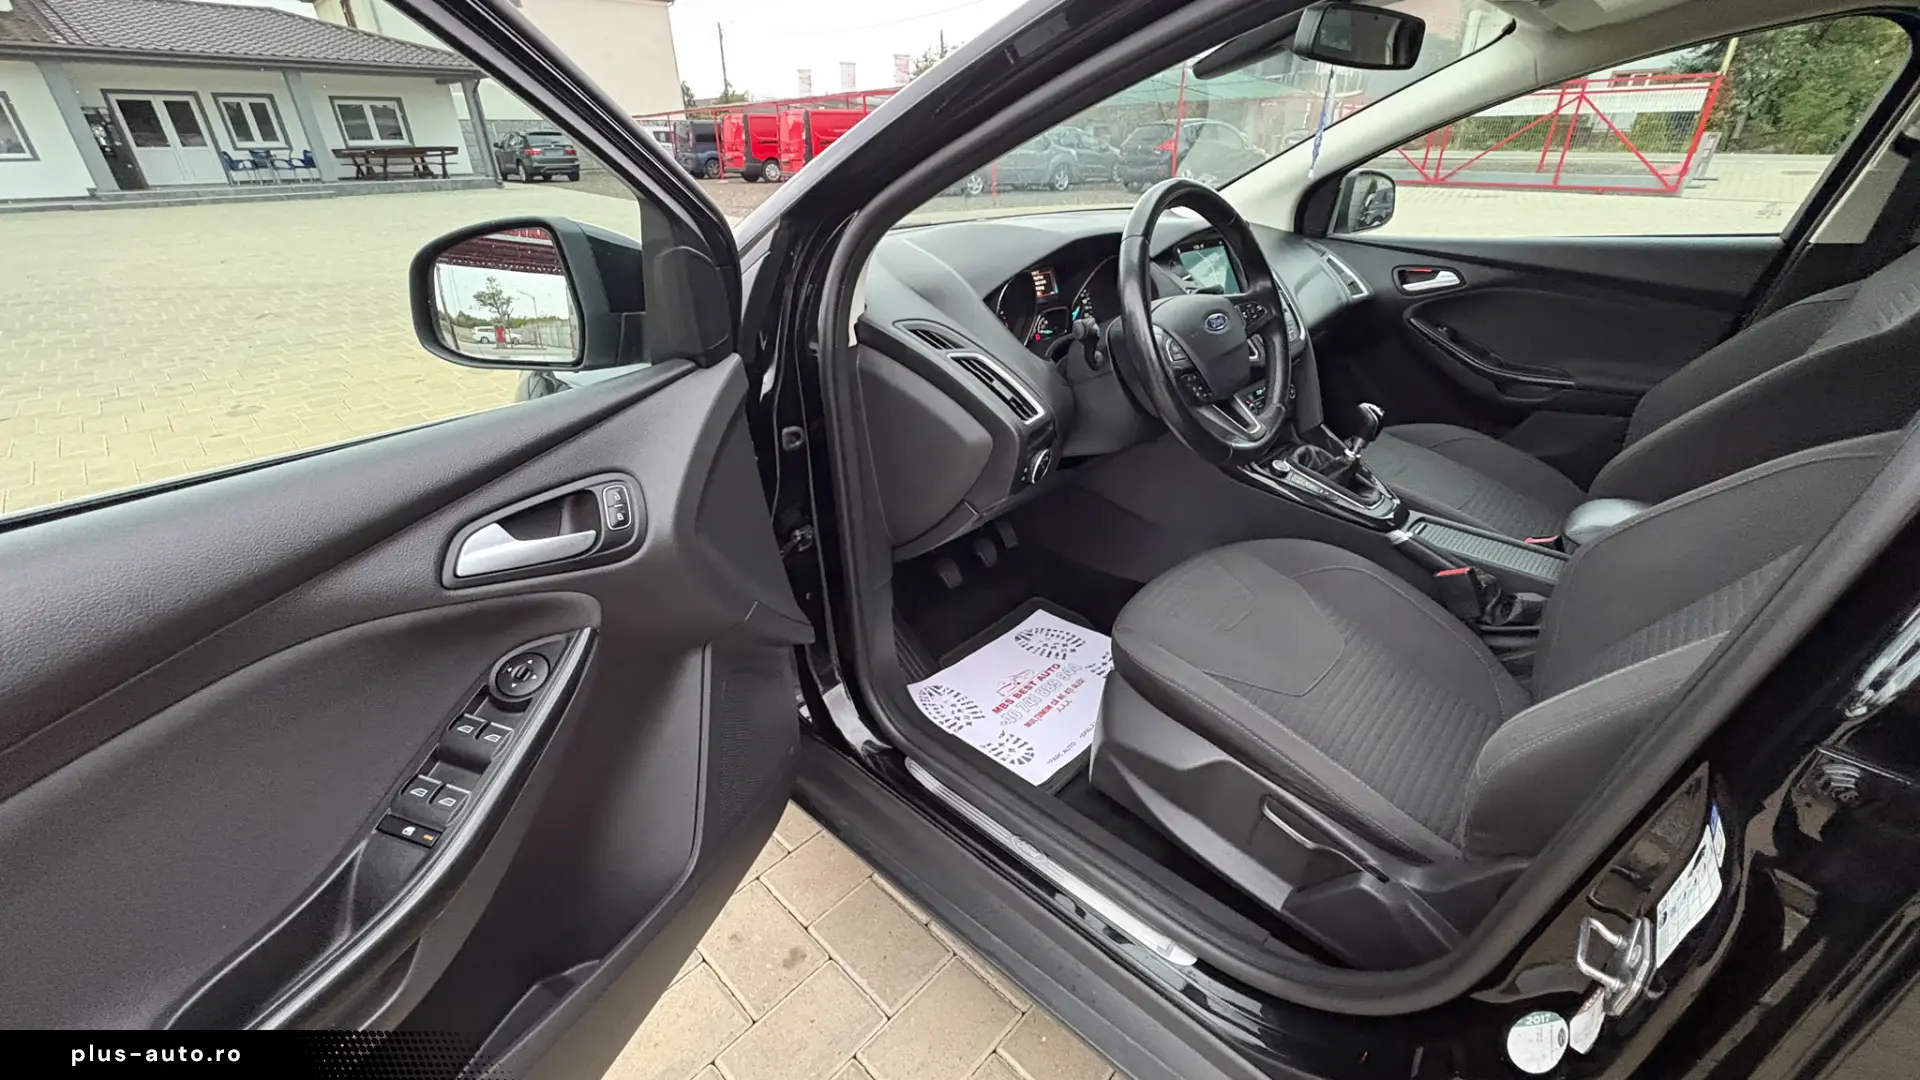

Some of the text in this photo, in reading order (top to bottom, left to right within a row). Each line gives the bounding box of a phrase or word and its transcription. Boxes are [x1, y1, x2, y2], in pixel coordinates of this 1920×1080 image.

[992, 663, 1061, 715] MBS BEST AUTO
[1015, 692, 1043, 713] 741
[1525, 1014, 1551, 1025] 2017
